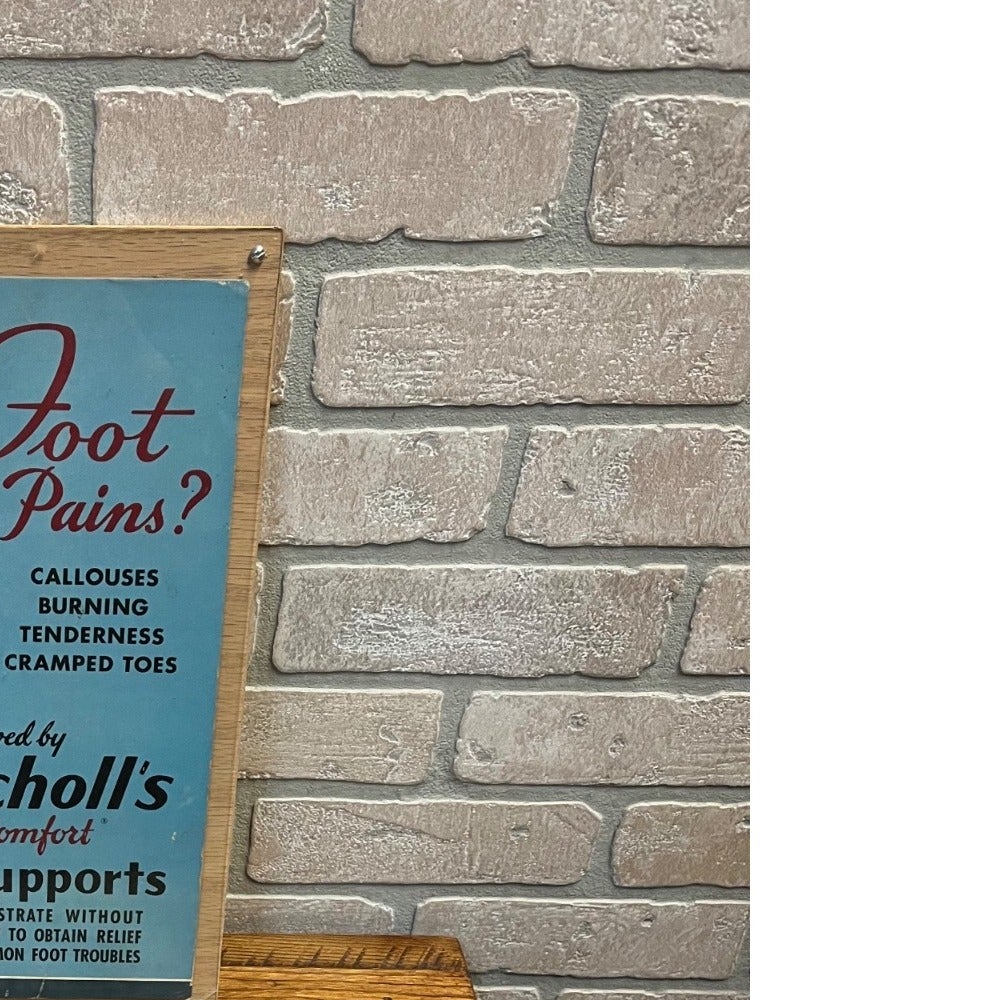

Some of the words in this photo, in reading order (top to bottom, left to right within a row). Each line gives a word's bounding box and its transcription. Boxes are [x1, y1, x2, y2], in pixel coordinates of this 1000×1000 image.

[0, 467, 212, 541] Pains?
[30, 567, 159, 587] CALLOUSES
[38, 597, 149, 616] BURNING
[20, 626, 164, 645] TENDERNESS
[5, 654, 114, 673] CRAMPED
[124, 656, 177, 673] TOES
[37, 720, 67, 757] by
[65, 910, 143, 924] WITHOUT
[8, 929, 27, 942] TO
[34, 929, 87, 943] OBTAIN
[97, 930, 142, 944] RELIEF
[31, 948, 68, 962] FOOT
[73, 949, 140, 964] TROUBLES
